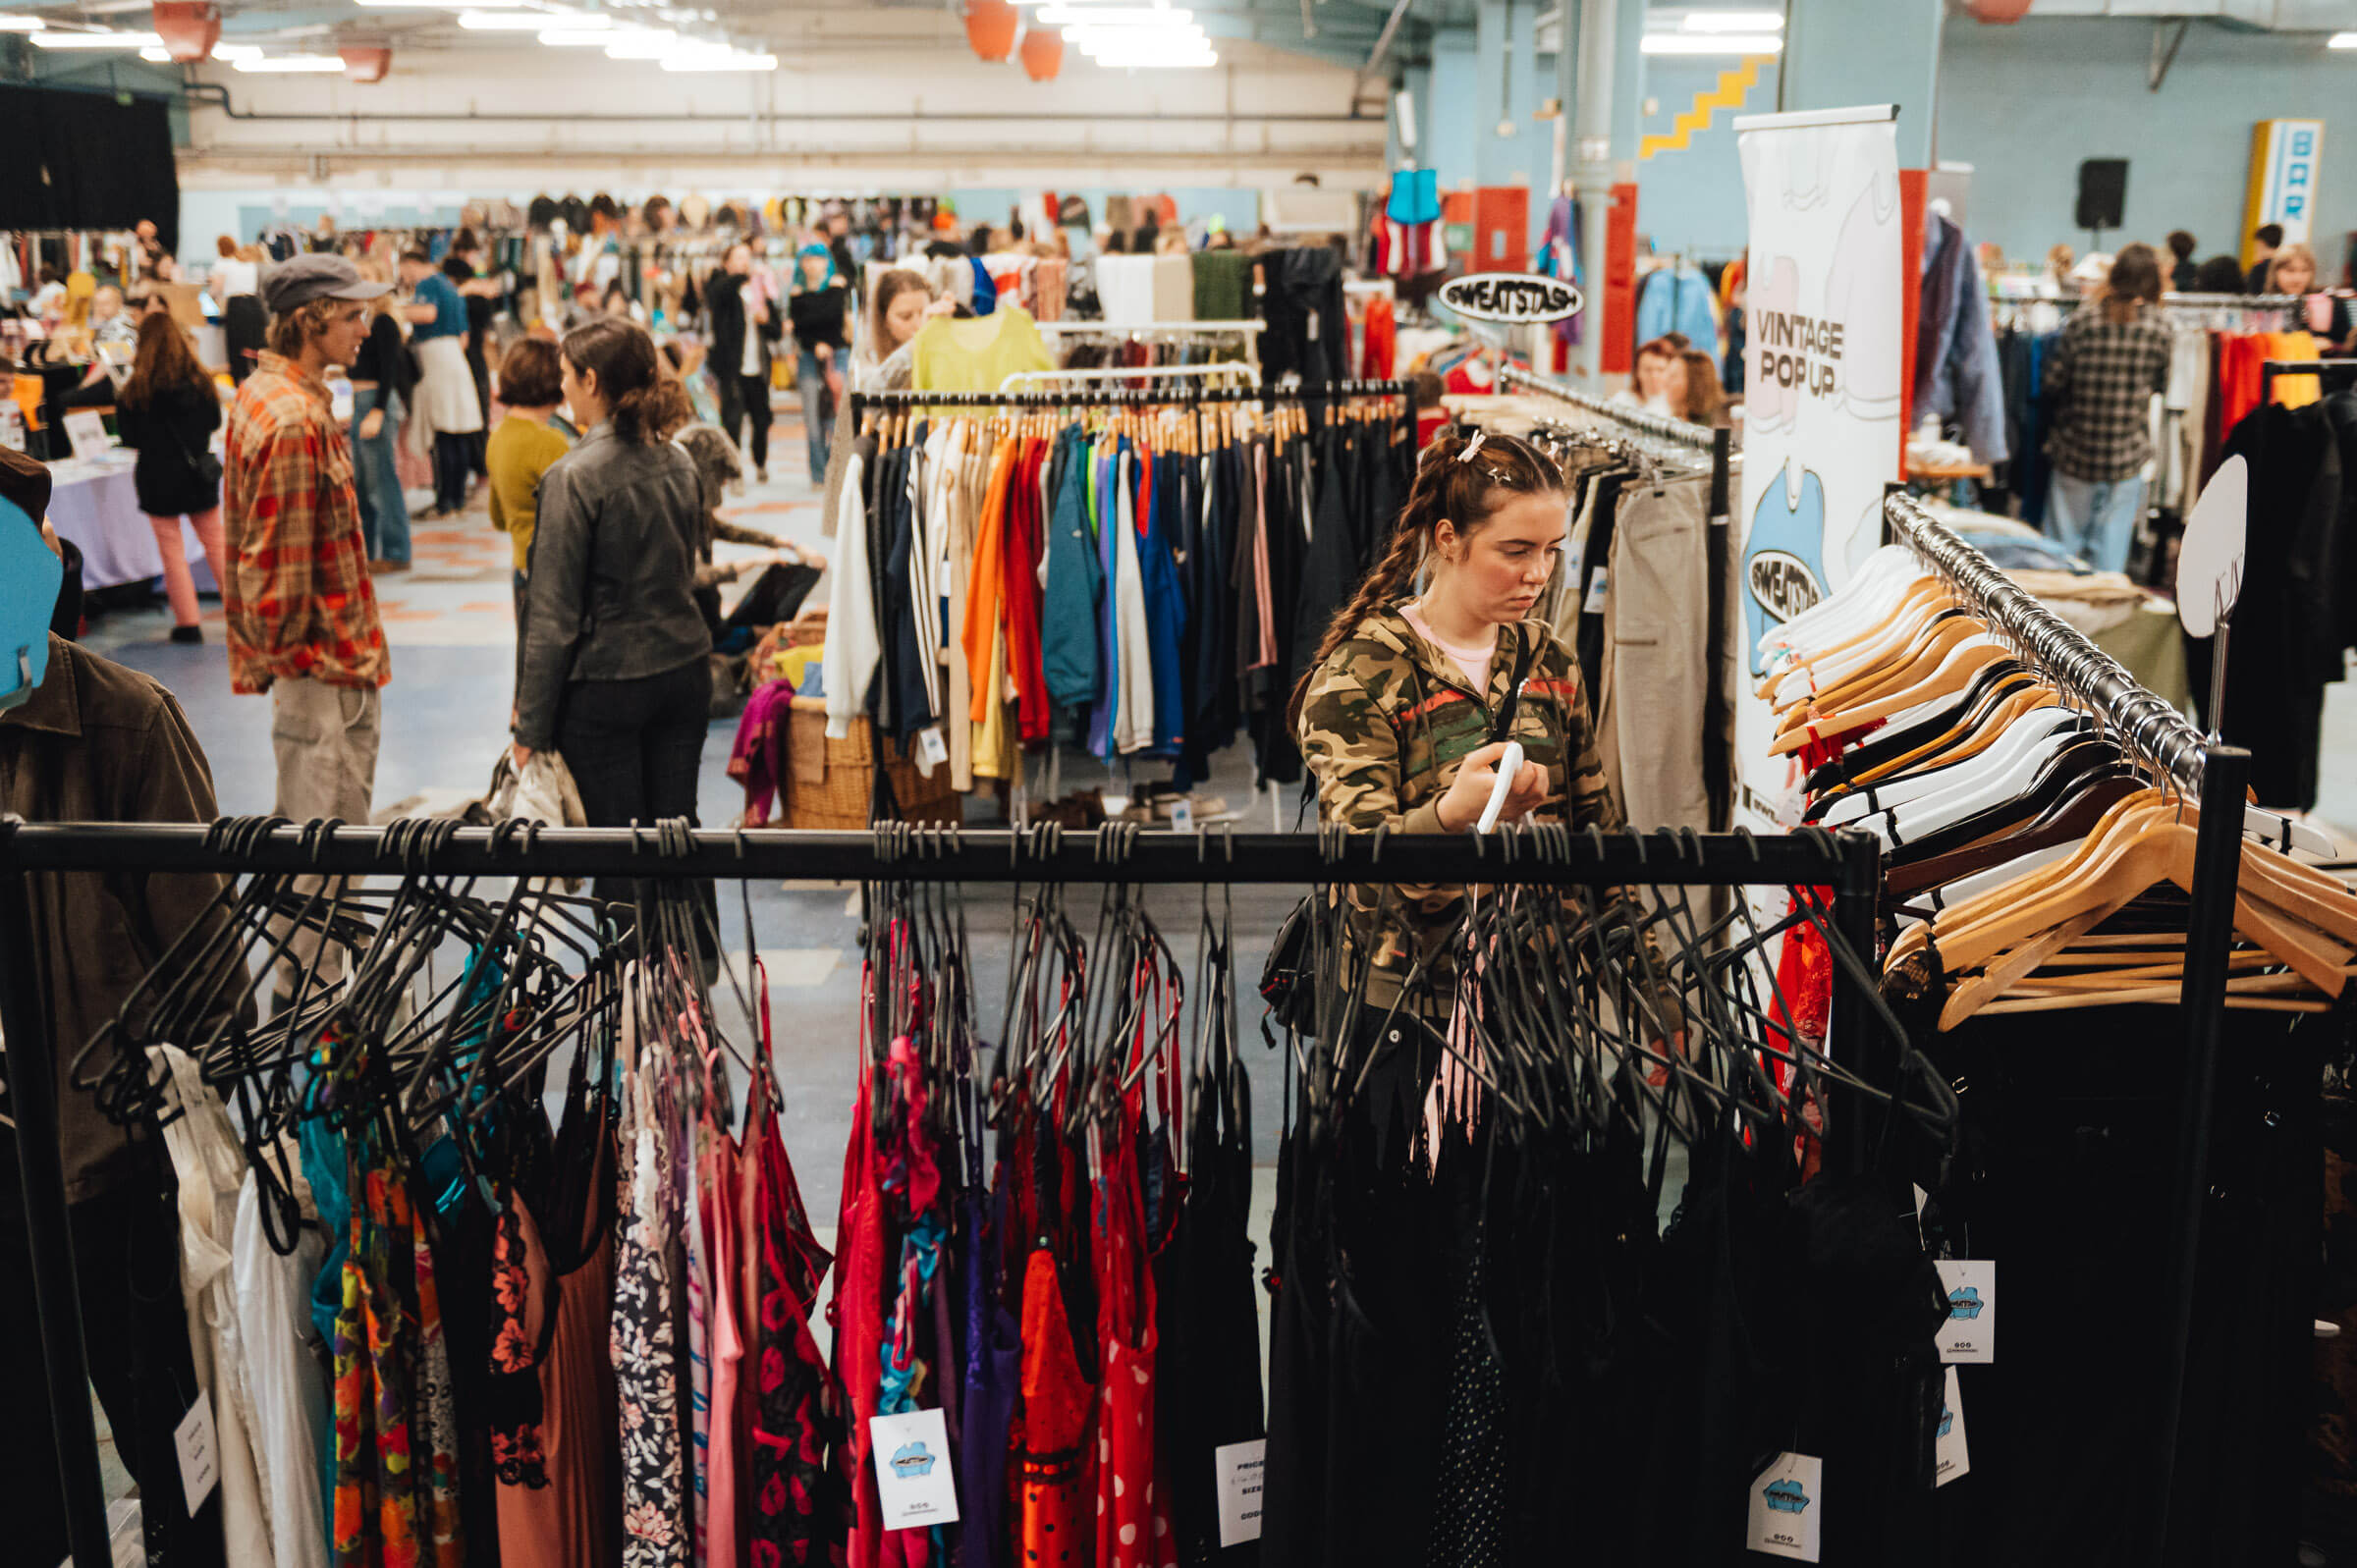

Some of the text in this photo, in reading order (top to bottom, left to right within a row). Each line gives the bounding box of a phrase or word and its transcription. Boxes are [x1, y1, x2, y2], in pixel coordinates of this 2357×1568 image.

[2284, 130, 2314, 221] BAR
[1756, 308, 1844, 361] VINTAGE
[1760, 350, 1836, 402] POP UP
